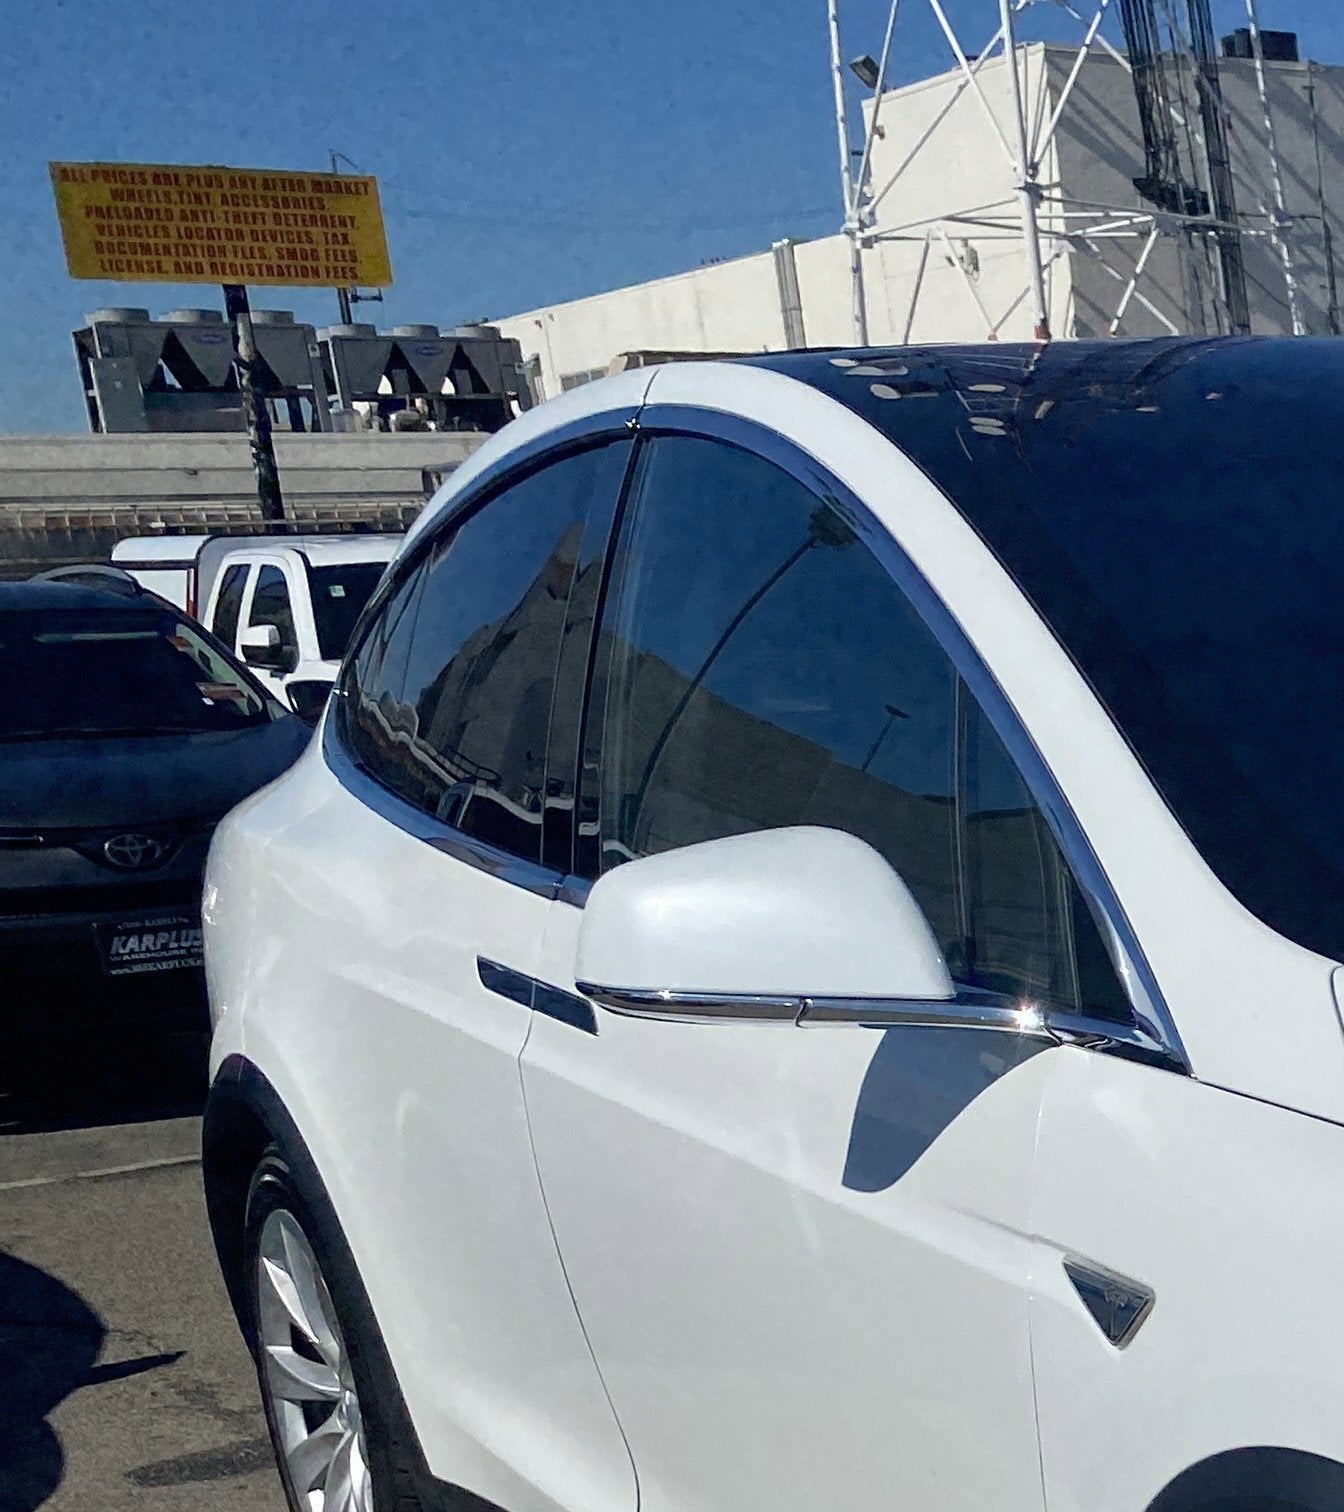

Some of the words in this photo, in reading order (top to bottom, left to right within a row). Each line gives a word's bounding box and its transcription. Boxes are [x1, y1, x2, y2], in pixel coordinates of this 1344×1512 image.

[59, 167, 87, 183] ALL
[92, 169, 147, 185] PRICES
[152, 172, 180, 187] ARE
[186, 173, 224, 189] PLUS
[262, 177, 307, 193] AFTER
[311, 179, 369, 196] MARKET
[84, 204, 174, 222] PRELOADED
[95, 223, 172, 239] VEHICLES
[175, 226, 245, 243] LOCATOR
[93, 240, 227, 258] DOCUMENTATION
[275, 247, 320, 262] SMOG
[173, 260, 205, 275] AND
[209, 261, 321, 279] REGISTRATION
